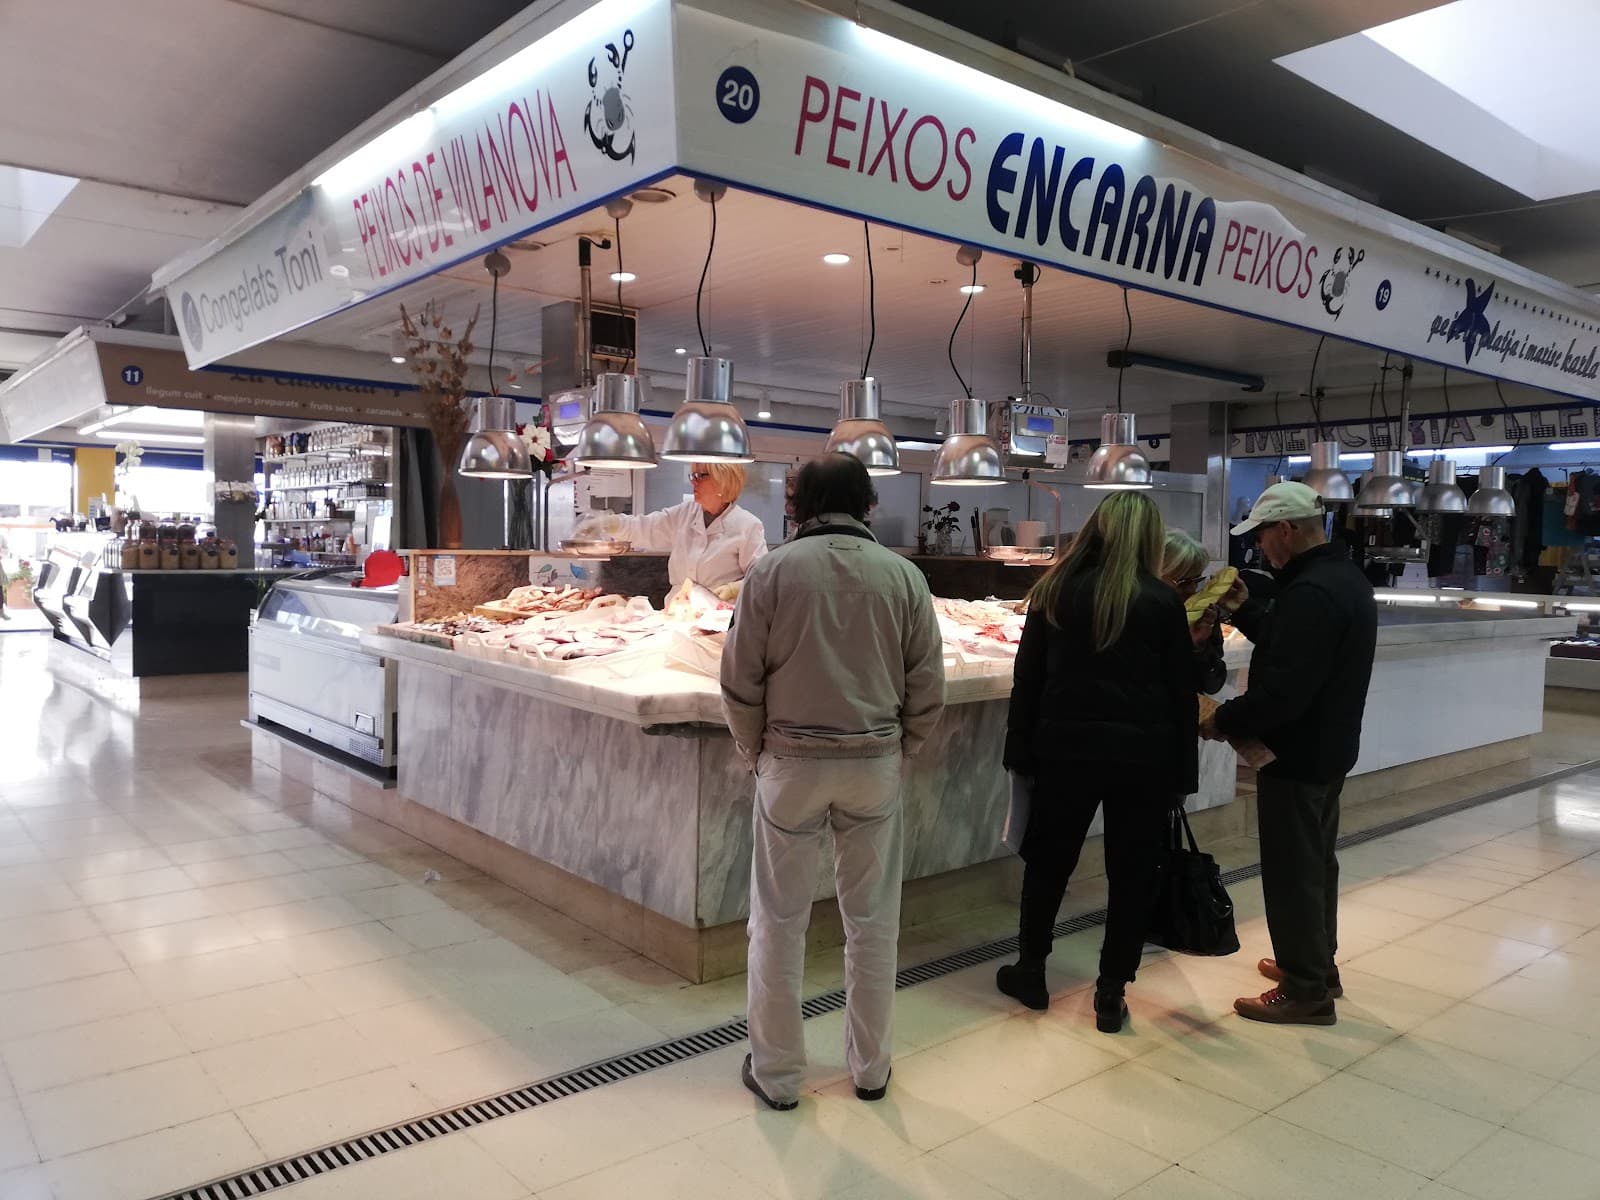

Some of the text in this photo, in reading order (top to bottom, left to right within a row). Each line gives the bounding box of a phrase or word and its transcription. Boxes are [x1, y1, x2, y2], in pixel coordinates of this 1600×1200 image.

[721, 79, 754, 111] 20
[352, 87, 578, 280] PEIXOS DE VILANOVA
[794, 75, 1319, 299] PEIXOS ENCARNA PEIXOS
[200, 264, 280, 333] Congelats
[274, 230, 323, 296] Toni
[1378, 287, 1391, 300] 19
[124, 369, 141, 383] 11
